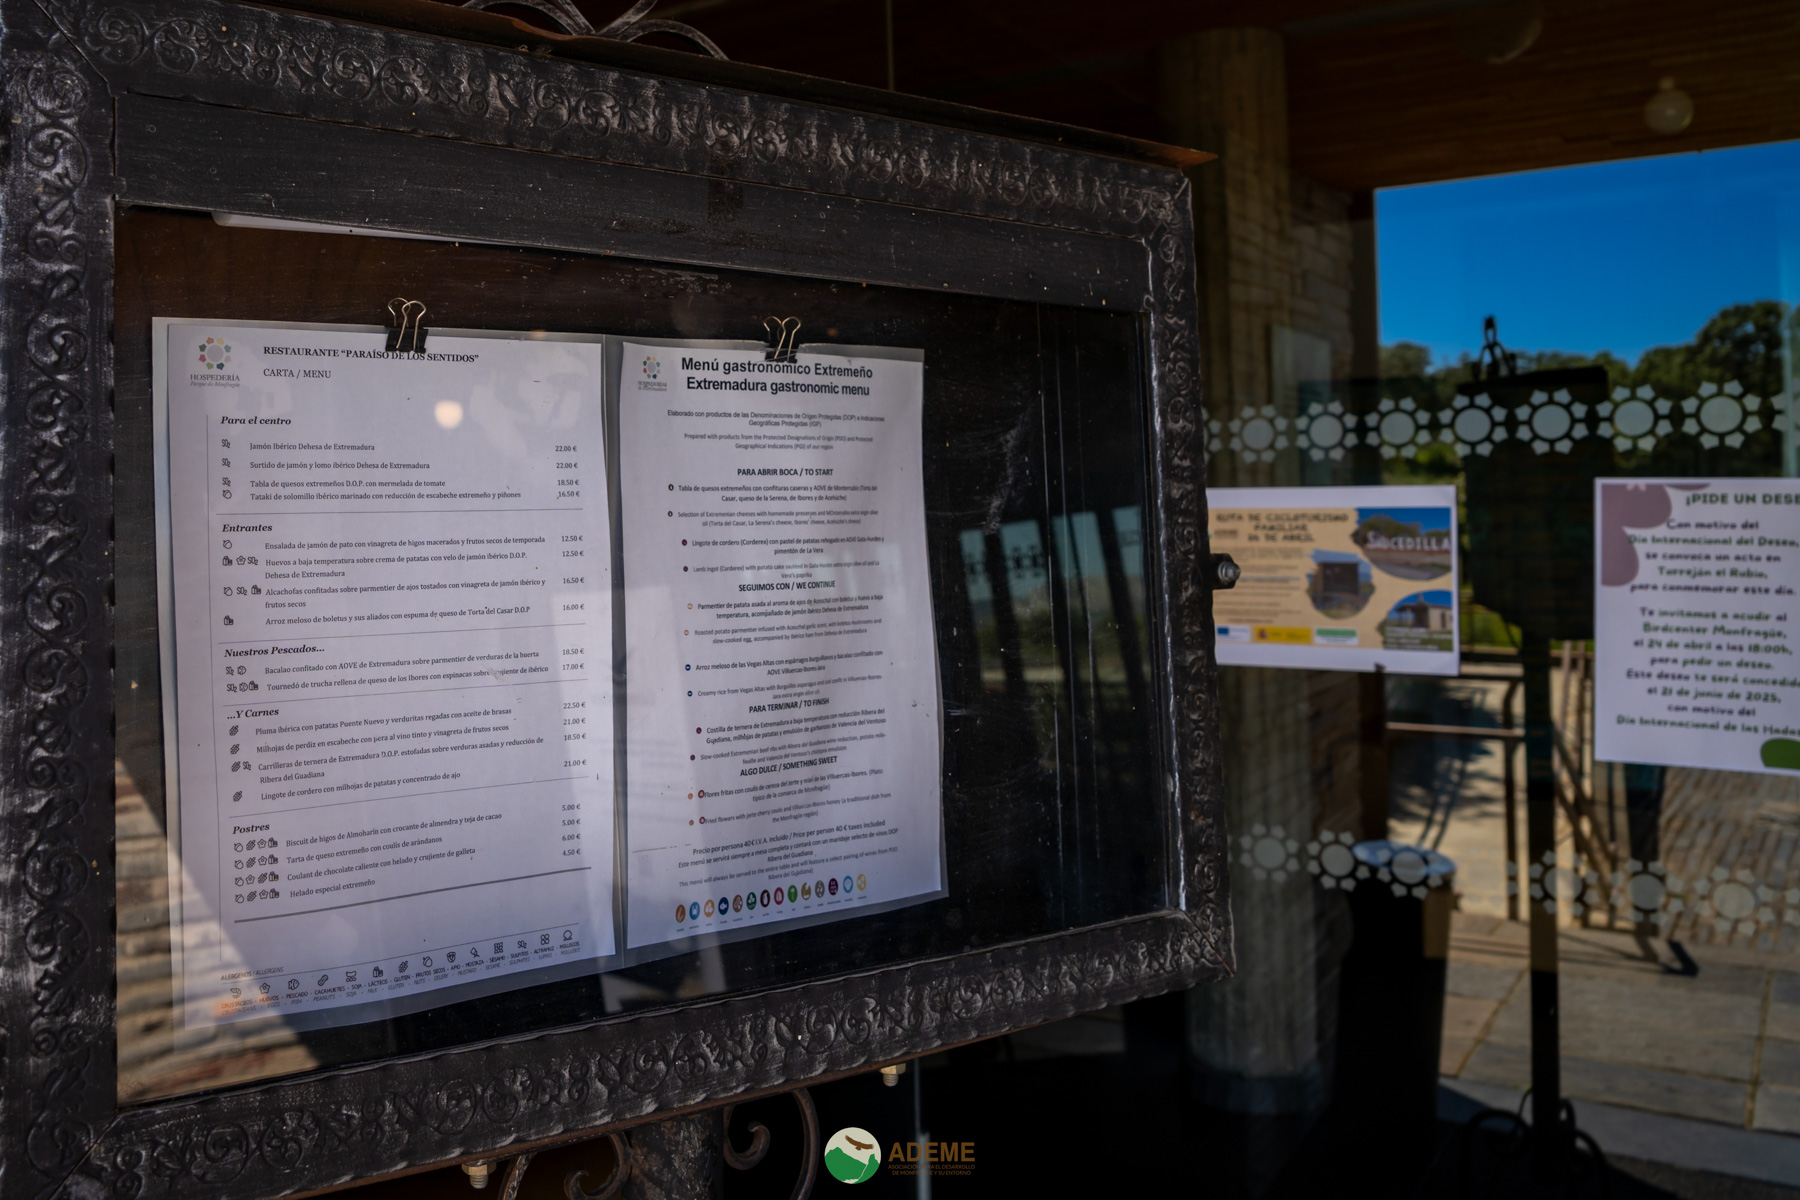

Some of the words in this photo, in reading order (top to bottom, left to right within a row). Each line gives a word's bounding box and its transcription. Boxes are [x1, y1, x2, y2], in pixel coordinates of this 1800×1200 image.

[263, 346, 339, 358] RESTAURANTE
[341, 349, 388, 360] “PARAÍSO
[392, 352, 405, 360] DE
[407, 352, 426, 361] LOS
[427, 353, 480, 363] SENTIDOS”
[682, 357, 718, 371] Menú
[814, 362, 872, 378] Extremeño
[190, 373, 240, 381] HOSPEDERÍA
[263, 368, 294, 377] CARTA
[303, 369, 331, 378] MENU
[687, 376, 767, 391] Extremadura
[770, 380, 839, 395] gastronomic
[841, 385, 869, 395] menu
[220, 416, 246, 424] Para
[248, 416, 257, 424] el
[249, 442, 271, 450] Jamón
[286, 461, 307, 469] jamón
[222, 524, 272, 532] Entrantes
[738, 583, 774, 591] SEGUIMOS
[807, 580, 835, 588] CONTINUE
[224, 648, 268, 657] Nuestros
[270, 644, 324, 654] Pescados...
[748, 704, 766, 713] PARA
[767, 701, 798, 711] TERMINAR
[244, 709, 279, 717] Carnes
[739, 767, 757, 776] ALGO
[758, 764, 777, 774] DULCE
[782, 758, 817, 770] SOMETHING
[818, 755, 837, 765] SWEET
[232, 824, 269, 834] Postres
[290, 888, 314, 897] Helado
[314, 883, 341, 894] especial
[342, 878, 375, 889] extremeño
